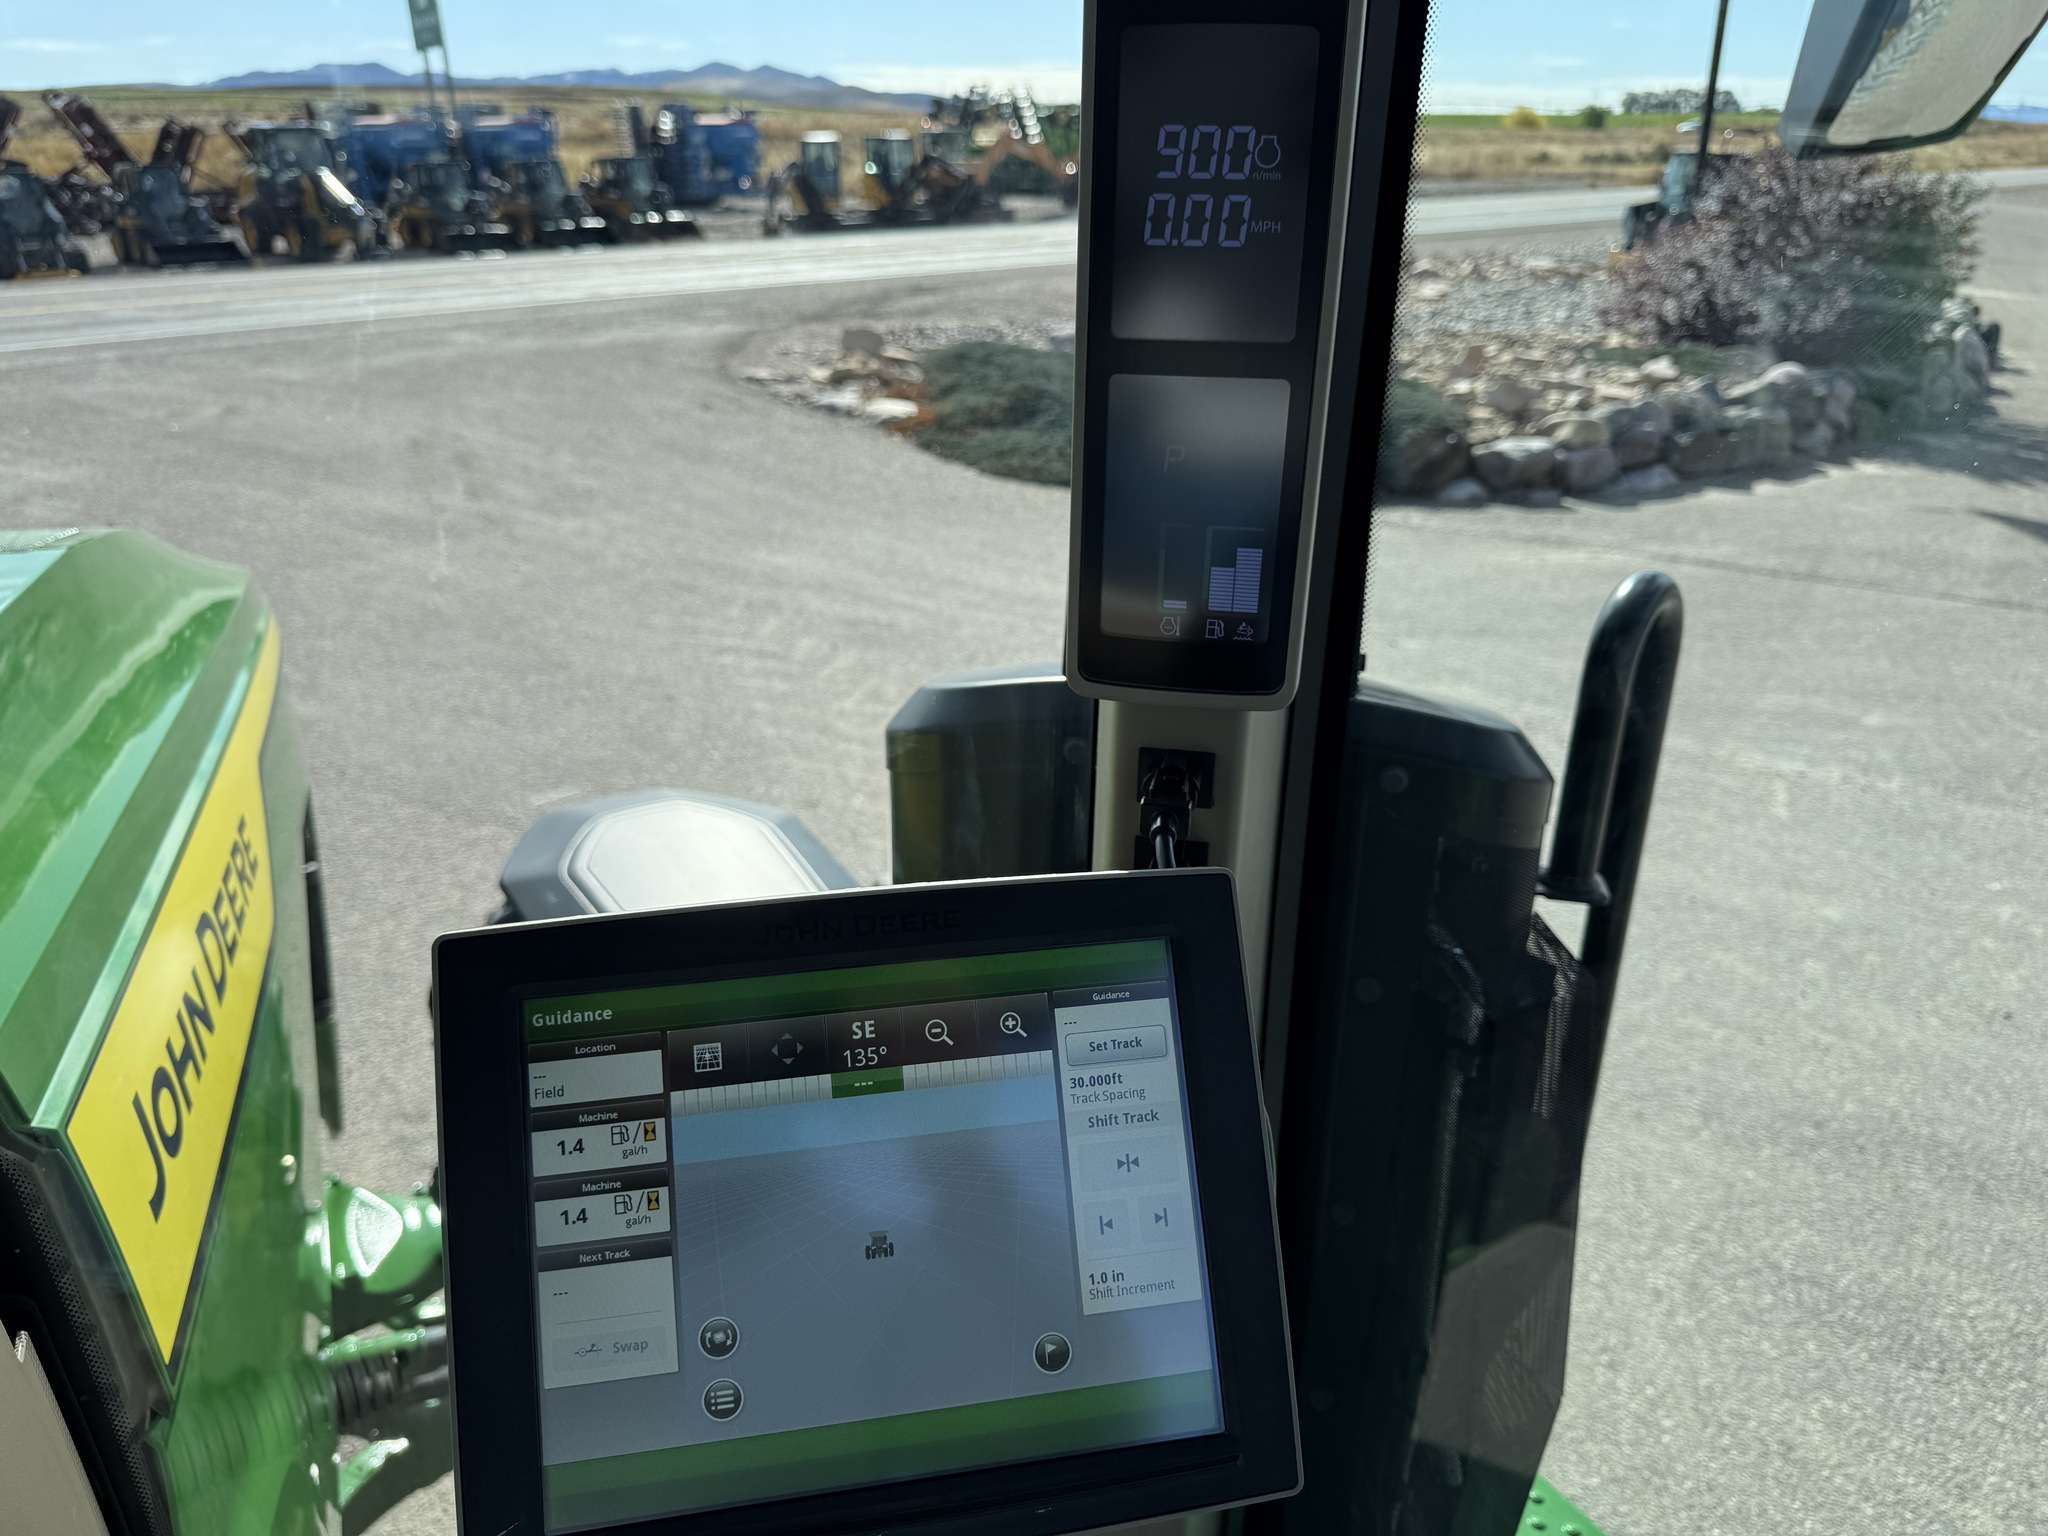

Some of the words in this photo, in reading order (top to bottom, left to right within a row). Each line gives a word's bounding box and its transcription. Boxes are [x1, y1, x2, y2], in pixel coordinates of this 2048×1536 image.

[1156, 124, 1256, 180] 900
[1252, 171, 1281, 181] n/min
[1143, 193, 1251, 247] 0.00
[1250, 221, 1281, 233] MPH
[1163, 445, 1185, 474] P
[754, 919, 843, 946] JOHN
[853, 909, 961, 936] DEERE
[1092, 990, 1130, 1001] Guidance
[132, 967, 216, 1224] JOHN
[195, 814, 260, 1008] DEERE
[532, 1006, 613, 1027] Guidance
[851, 1019, 876, 1040] SE
[574, 1042, 617, 1055] Location
[1088, 1039, 1109, 1053] Set
[1110, 1036, 1143, 1050] Track
[1069, 1072, 1123, 1089] 30.000ft
[533, 1085, 565, 1099] Field
[1070, 1091, 1100, 1105] Track
[1102, 1086, 1146, 1103] Spacing
[578, 1110, 619, 1123] Machine
[1087, 1113, 1120, 1128] Shift
[1122, 1109, 1160, 1125] Track
[556, 1138, 585, 1156] 1.4
[621, 1144, 648, 1159] gal/h
[581, 1179, 622, 1192] Machine
[559, 1207, 589, 1226] 1.4
[625, 1214, 652, 1229] gal/h
[578, 1252, 602, 1264] Next
[604, 1248, 631, 1260] Track
[1088, 1272, 1108, 1286] 1.0
[1112, 1269, 1125, 1283] in
[1089, 1285, 1114, 1300] Shift
[1117, 1279, 1175, 1297] Increment
[612, 1338, 649, 1354] Swap
